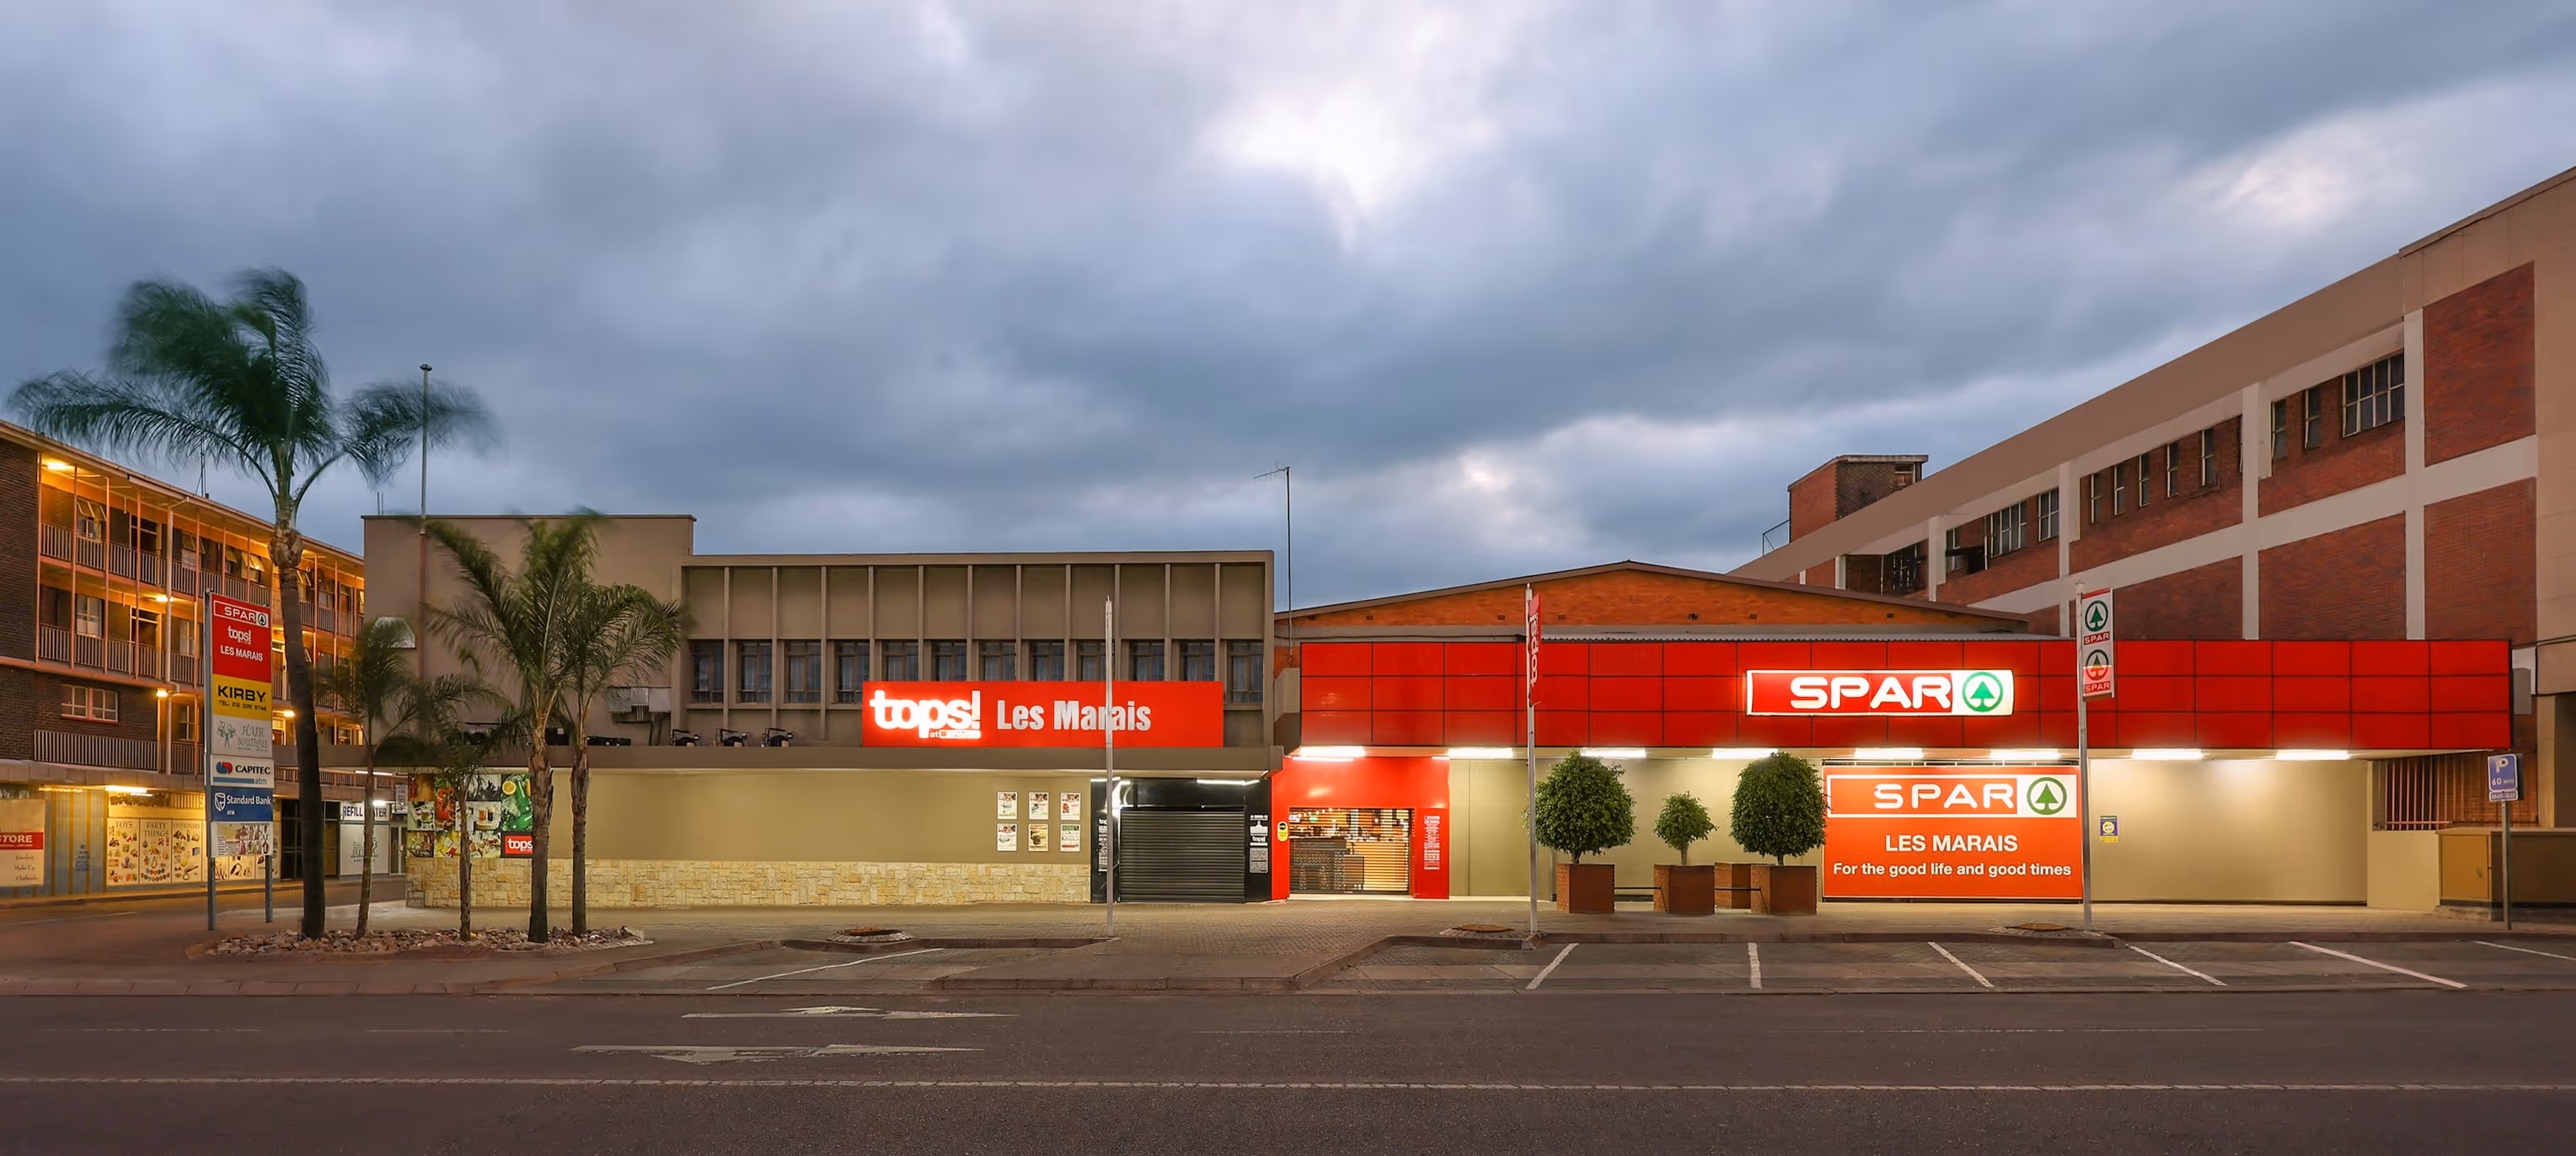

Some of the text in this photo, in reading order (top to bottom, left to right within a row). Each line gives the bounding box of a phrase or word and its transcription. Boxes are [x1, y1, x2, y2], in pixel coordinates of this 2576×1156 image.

[224, 606, 256, 622] SPAR
[227, 625, 251, 643] tops!
[2084, 632, 2109, 644] SPAR
[220, 645, 263, 661] LES MARAIS
[217, 685, 266, 703] KIRBY
[1790, 677, 1952, 709] SPAR
[2085, 682, 2110, 693] SPAR
[869, 689, 981, 738] tops!
[997, 700, 1151, 731] Les Marais
[235, 764, 270, 774] CAPITEC
[2492, 778, 2502, 786] 60
[227, 795, 271, 805] Standard Bank
[1874, 784, 2014, 809] SPAR
[342, 805, 387, 817] REFILL TER
[0, 834, 33, 843] TORE
[1885, 834, 2018, 852] LES MARAIS
[1833, 862, 2072, 878] For the good life and good times
